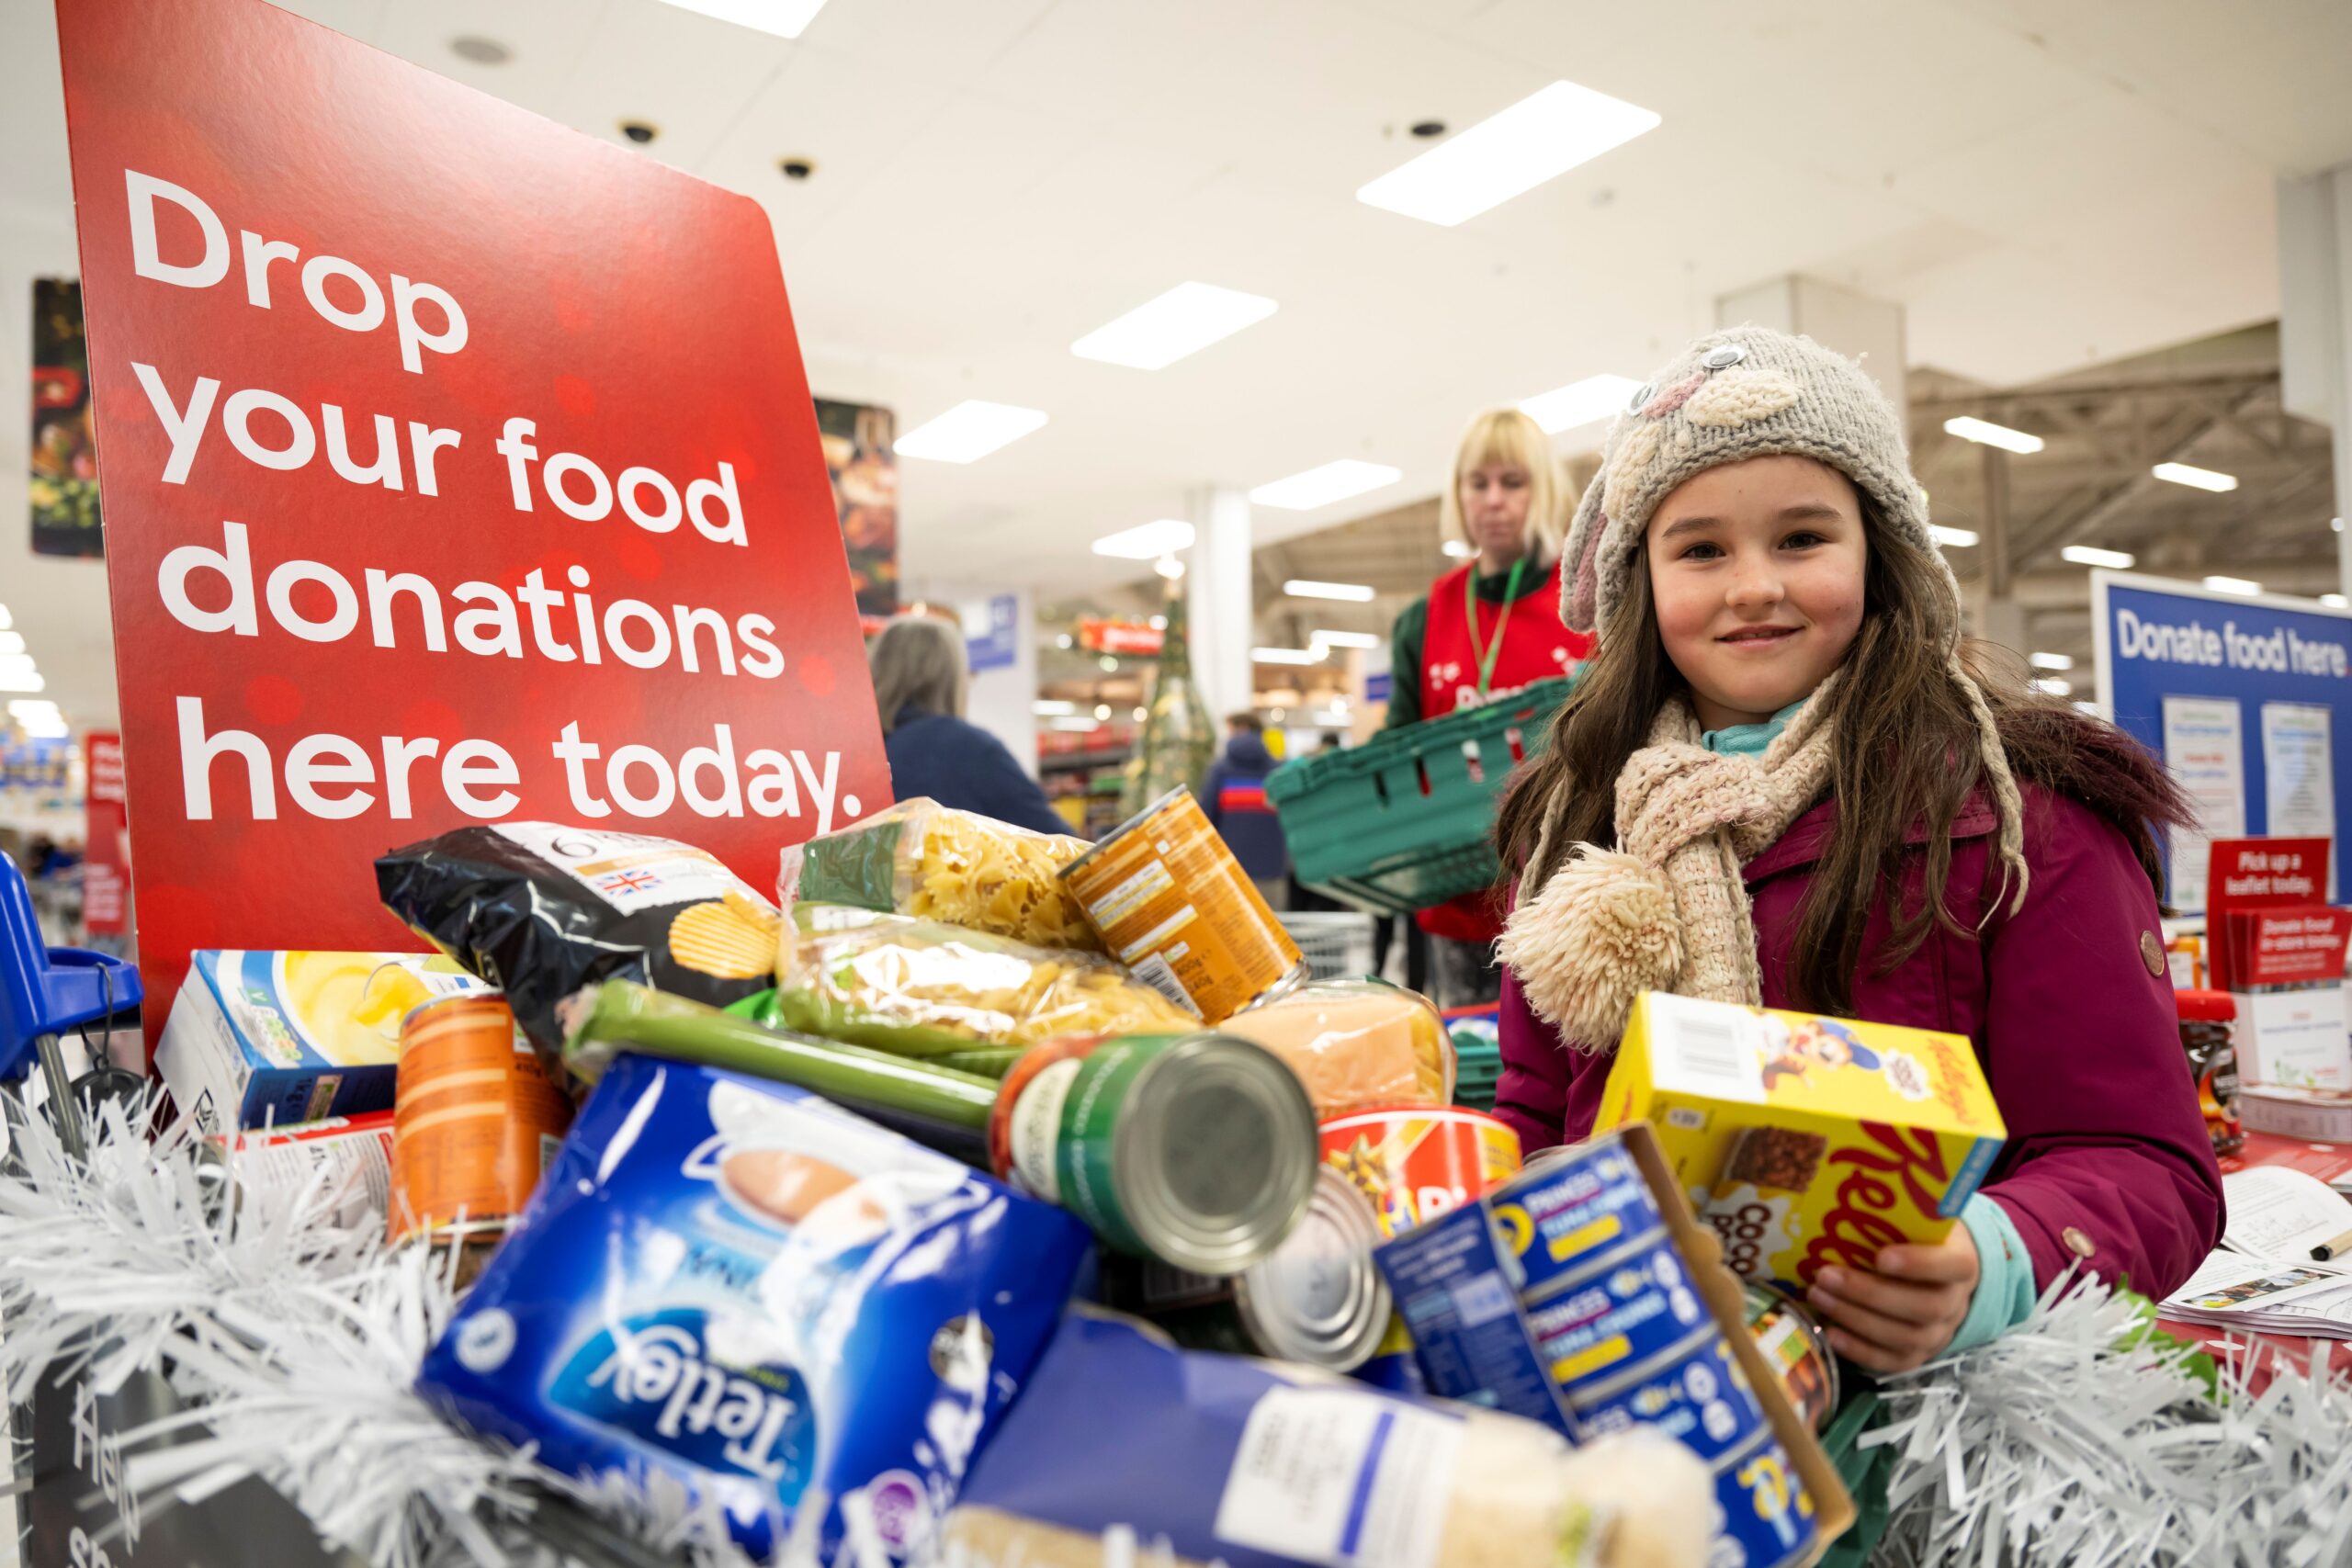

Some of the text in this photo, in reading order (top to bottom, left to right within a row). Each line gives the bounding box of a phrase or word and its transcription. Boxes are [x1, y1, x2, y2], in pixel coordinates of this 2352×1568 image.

[125, 169, 469, 375] Drop
[130, 361, 749, 547] your food
[157, 522, 786, 680] donations
[2117, 608, 2223, 667] Donate
[2223, 621, 2287, 672] food
[176, 695, 521, 821] here
[553, 719, 862, 836] today.
[2225, 874, 2314, 897] leaflet today.
[2238, 851, 2301, 874] Pick up a
[585, 1324, 797, 1483] Tetley
